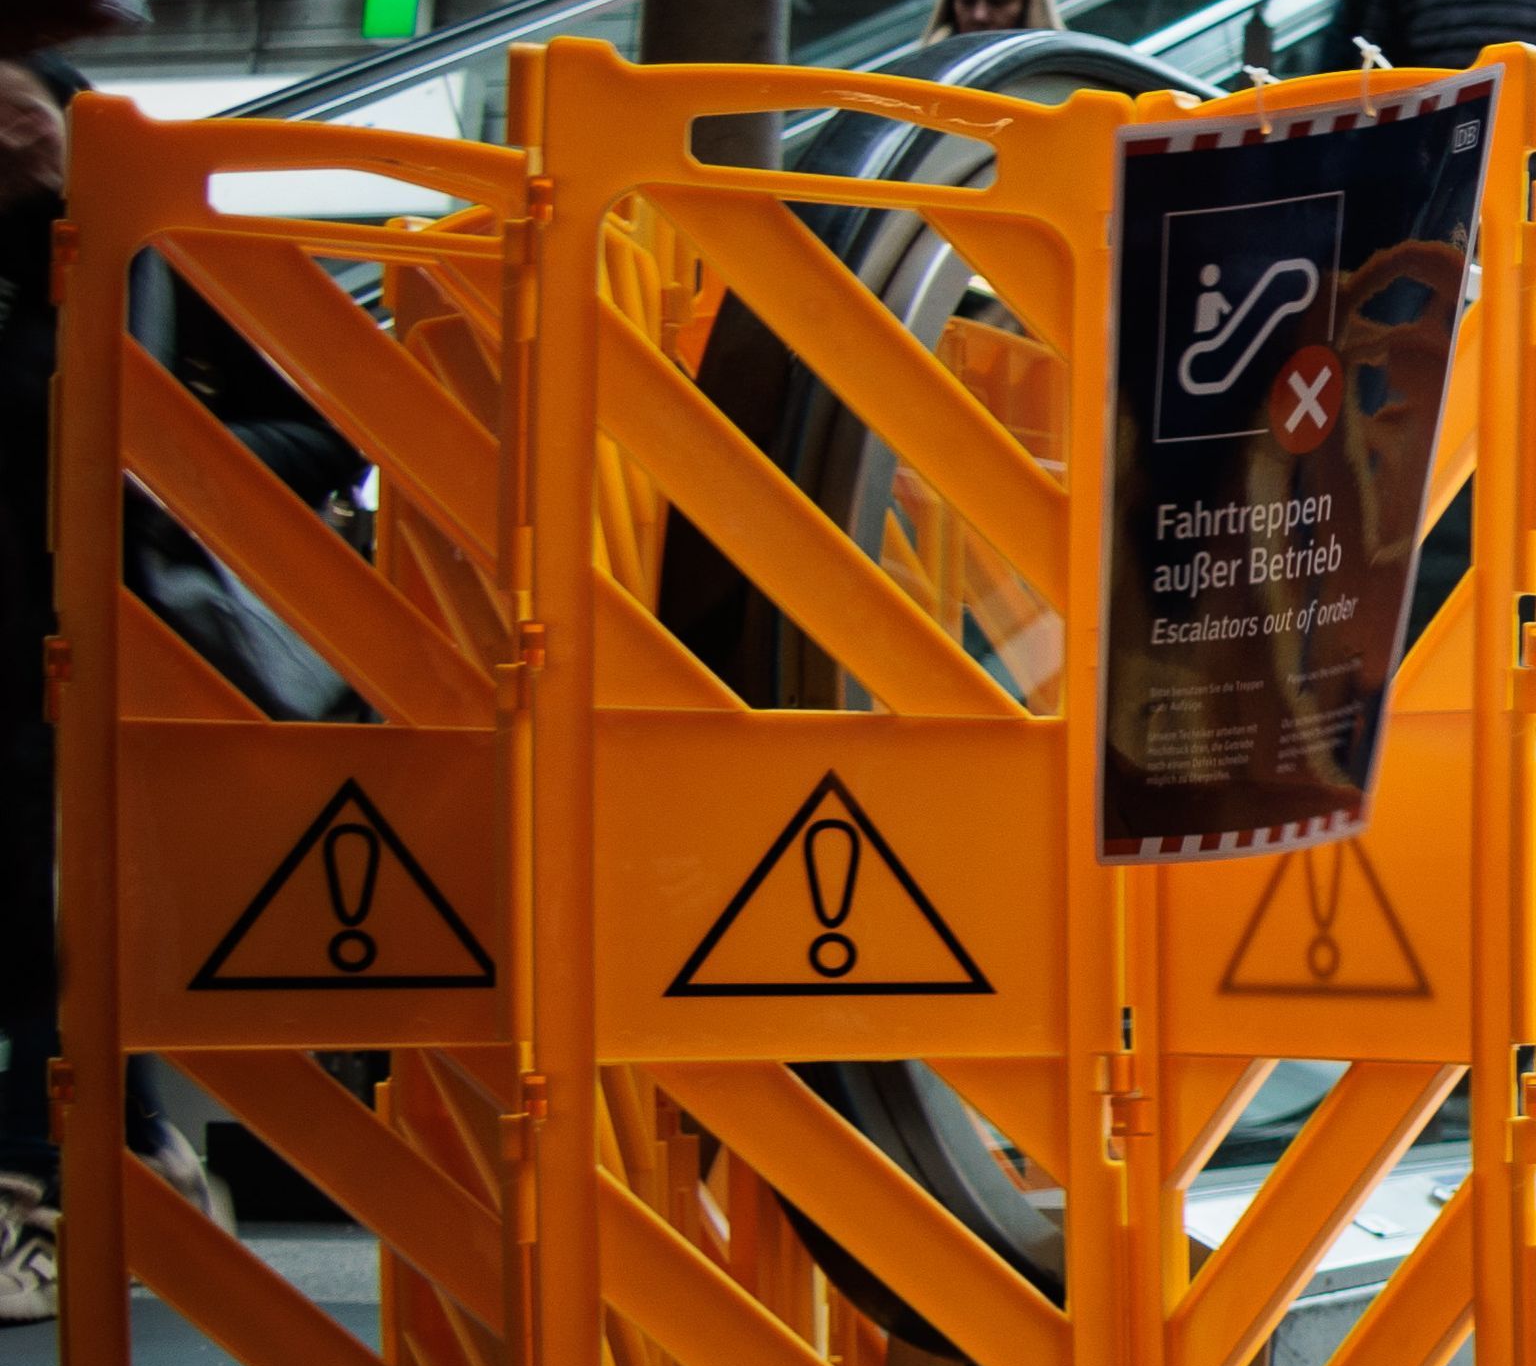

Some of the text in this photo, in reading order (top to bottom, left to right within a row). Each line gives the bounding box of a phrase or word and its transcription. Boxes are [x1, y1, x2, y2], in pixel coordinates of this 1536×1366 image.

[1455, 123, 1478, 149] DB
[1156, 491, 1333, 543] Fahrtreppen
[1152, 533, 1343, 597] außer Betrieb
[1150, 597, 1359, 646] Escalators out of order
